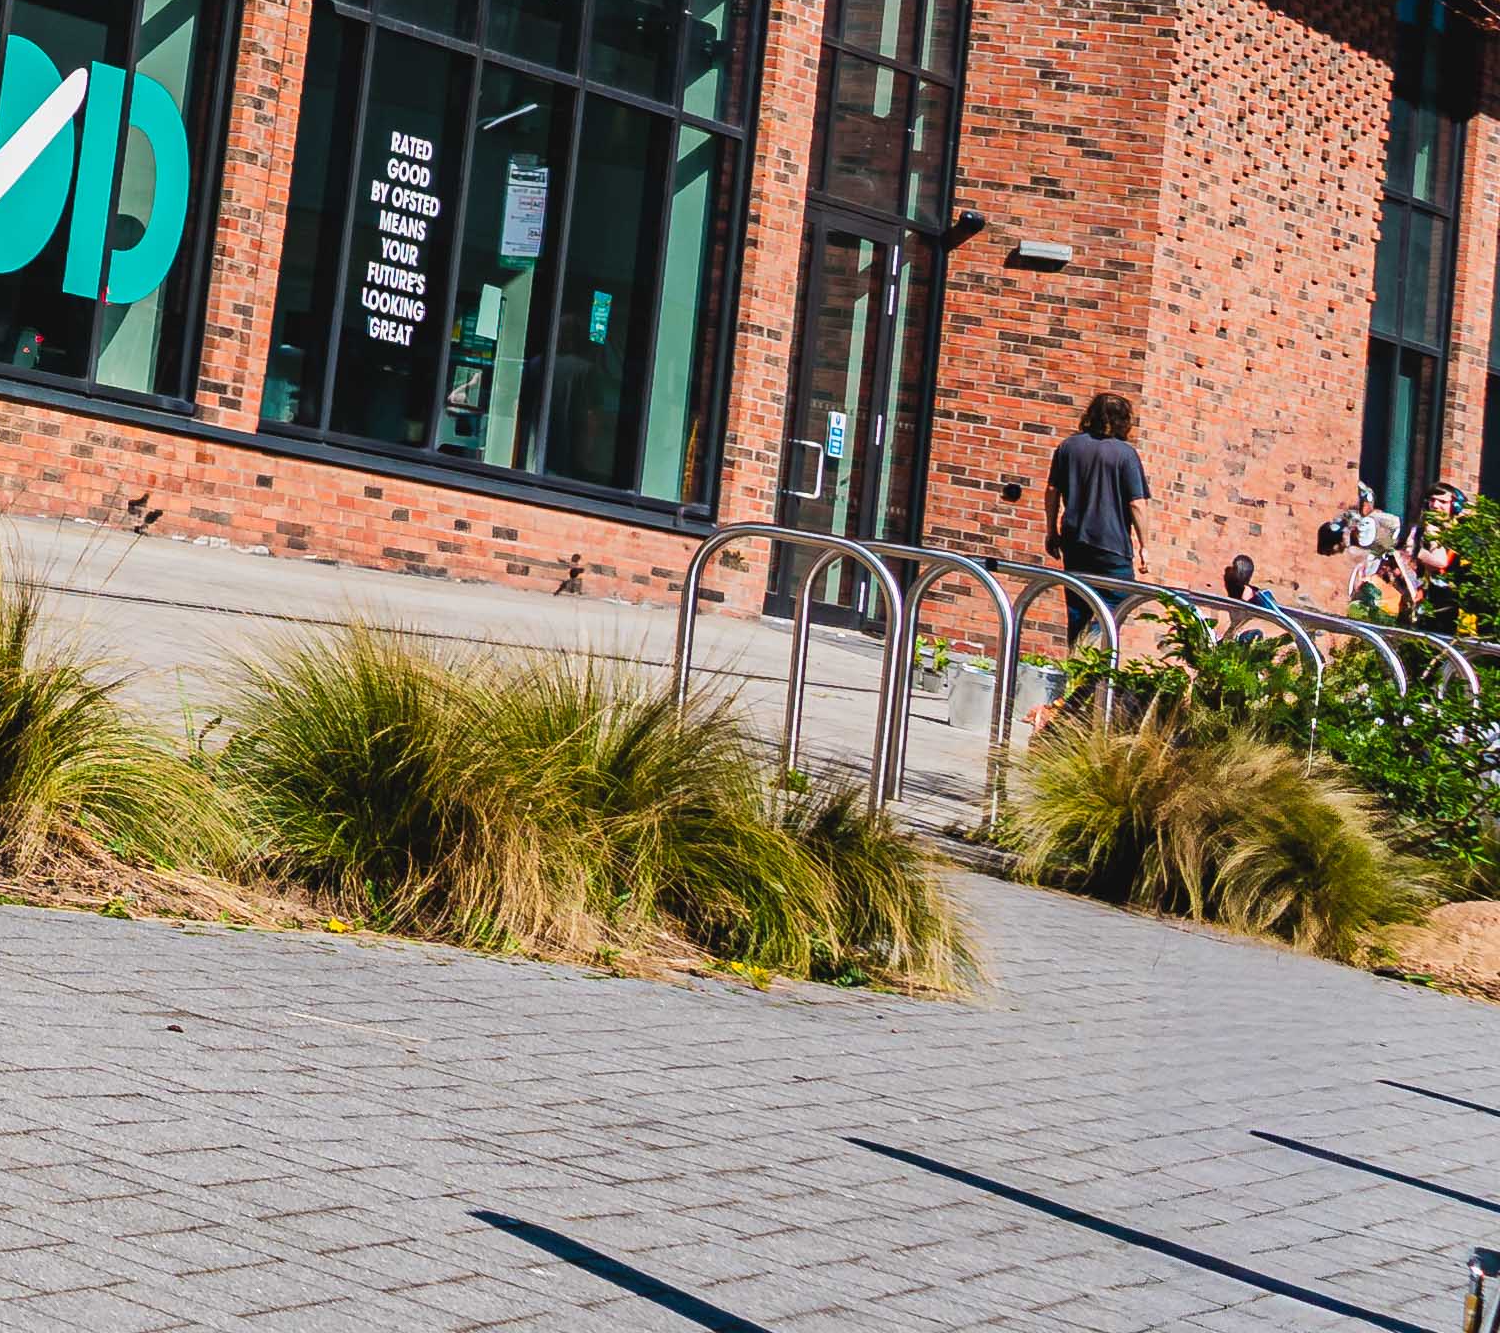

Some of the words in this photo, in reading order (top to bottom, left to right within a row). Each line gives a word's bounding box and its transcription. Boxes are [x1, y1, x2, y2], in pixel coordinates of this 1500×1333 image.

[391, 132, 432, 161] RATED
[387, 159, 430, 187] GOOD
[371, 181, 389, 203] BY
[393, 187, 439, 217] OFSTED
[380, 210, 426, 240] MEANS
[382, 237, 418, 265] YOUR
[368, 262, 425, 294] FUTURE'S
[362, 287, 425, 321] LOOKING
[370, 318, 413, 345] GREAT
